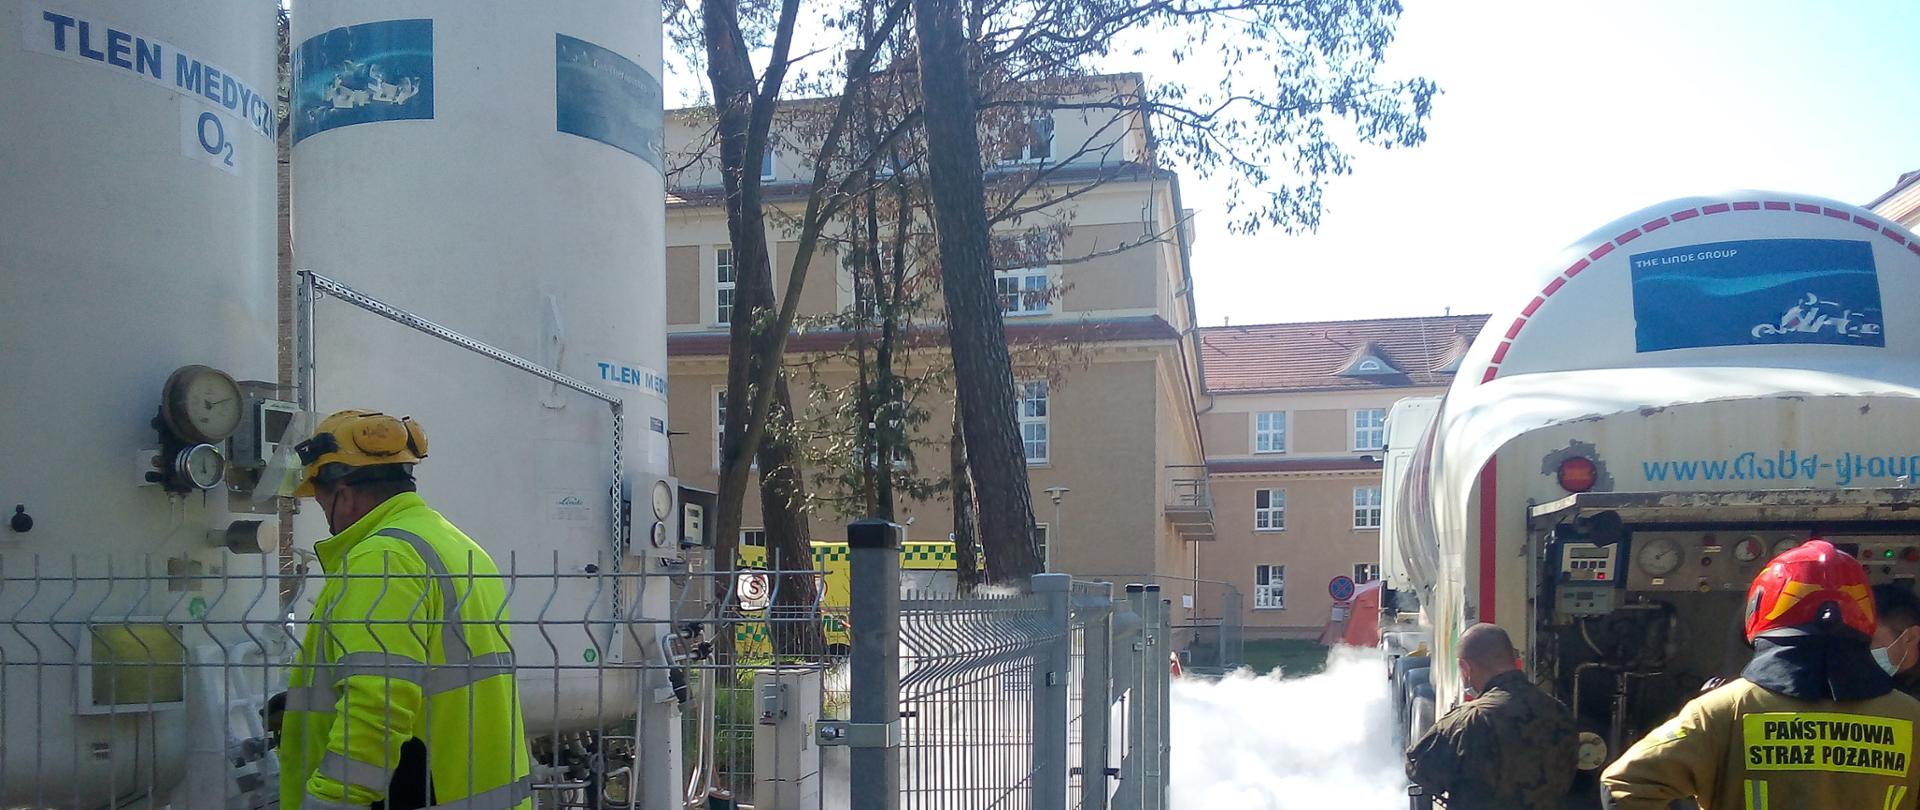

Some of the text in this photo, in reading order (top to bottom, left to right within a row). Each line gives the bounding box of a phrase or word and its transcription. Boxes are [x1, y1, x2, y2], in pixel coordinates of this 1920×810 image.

[43, 11, 162, 79] TLEN
[1635, 249, 1737, 268] THE LINDE GROUP
[598, 363, 640, 386] TLEN
[1764, 717, 1895, 745] PAŃSTWOWA
[1750, 746, 1906, 771] STRAŻ POŻARNA
